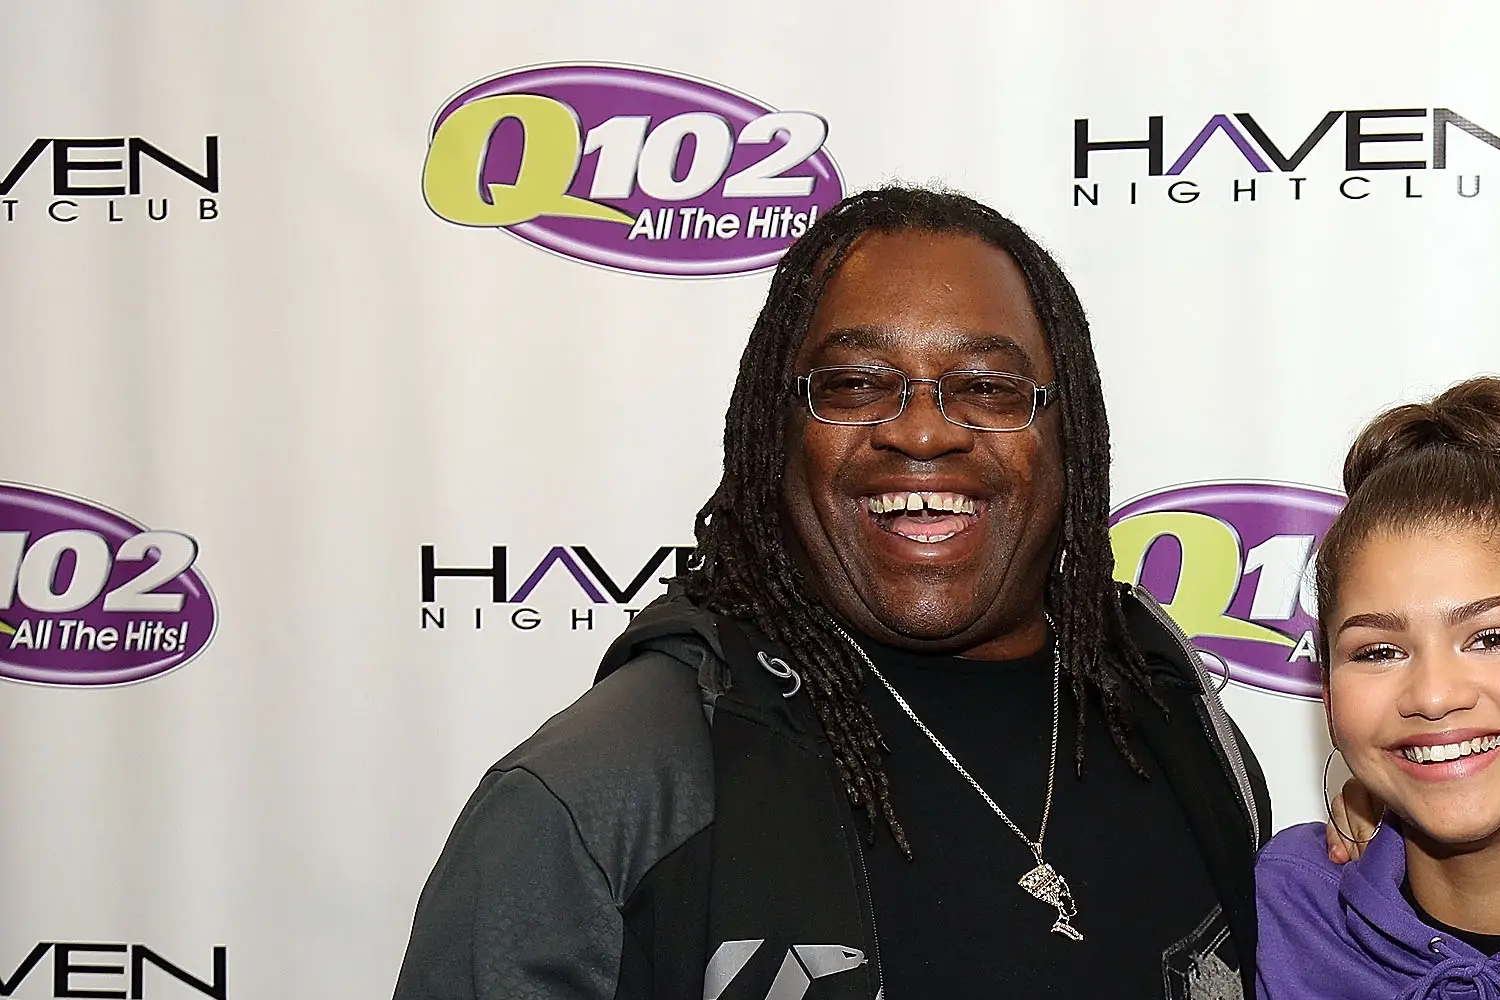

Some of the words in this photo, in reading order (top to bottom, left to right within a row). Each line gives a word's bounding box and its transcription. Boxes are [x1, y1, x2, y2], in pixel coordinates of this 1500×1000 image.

[422, 93, 829, 228] Q102
[2, 198, 219, 222] TCLUB
[627, 207, 675, 240] All
[679, 206, 741, 240] The
[1108, 509, 1319, 648] Q1
[9, 619, 52, 650] All
[59, 619, 119, 650] The
[124, 620, 189, 651] Hits!
